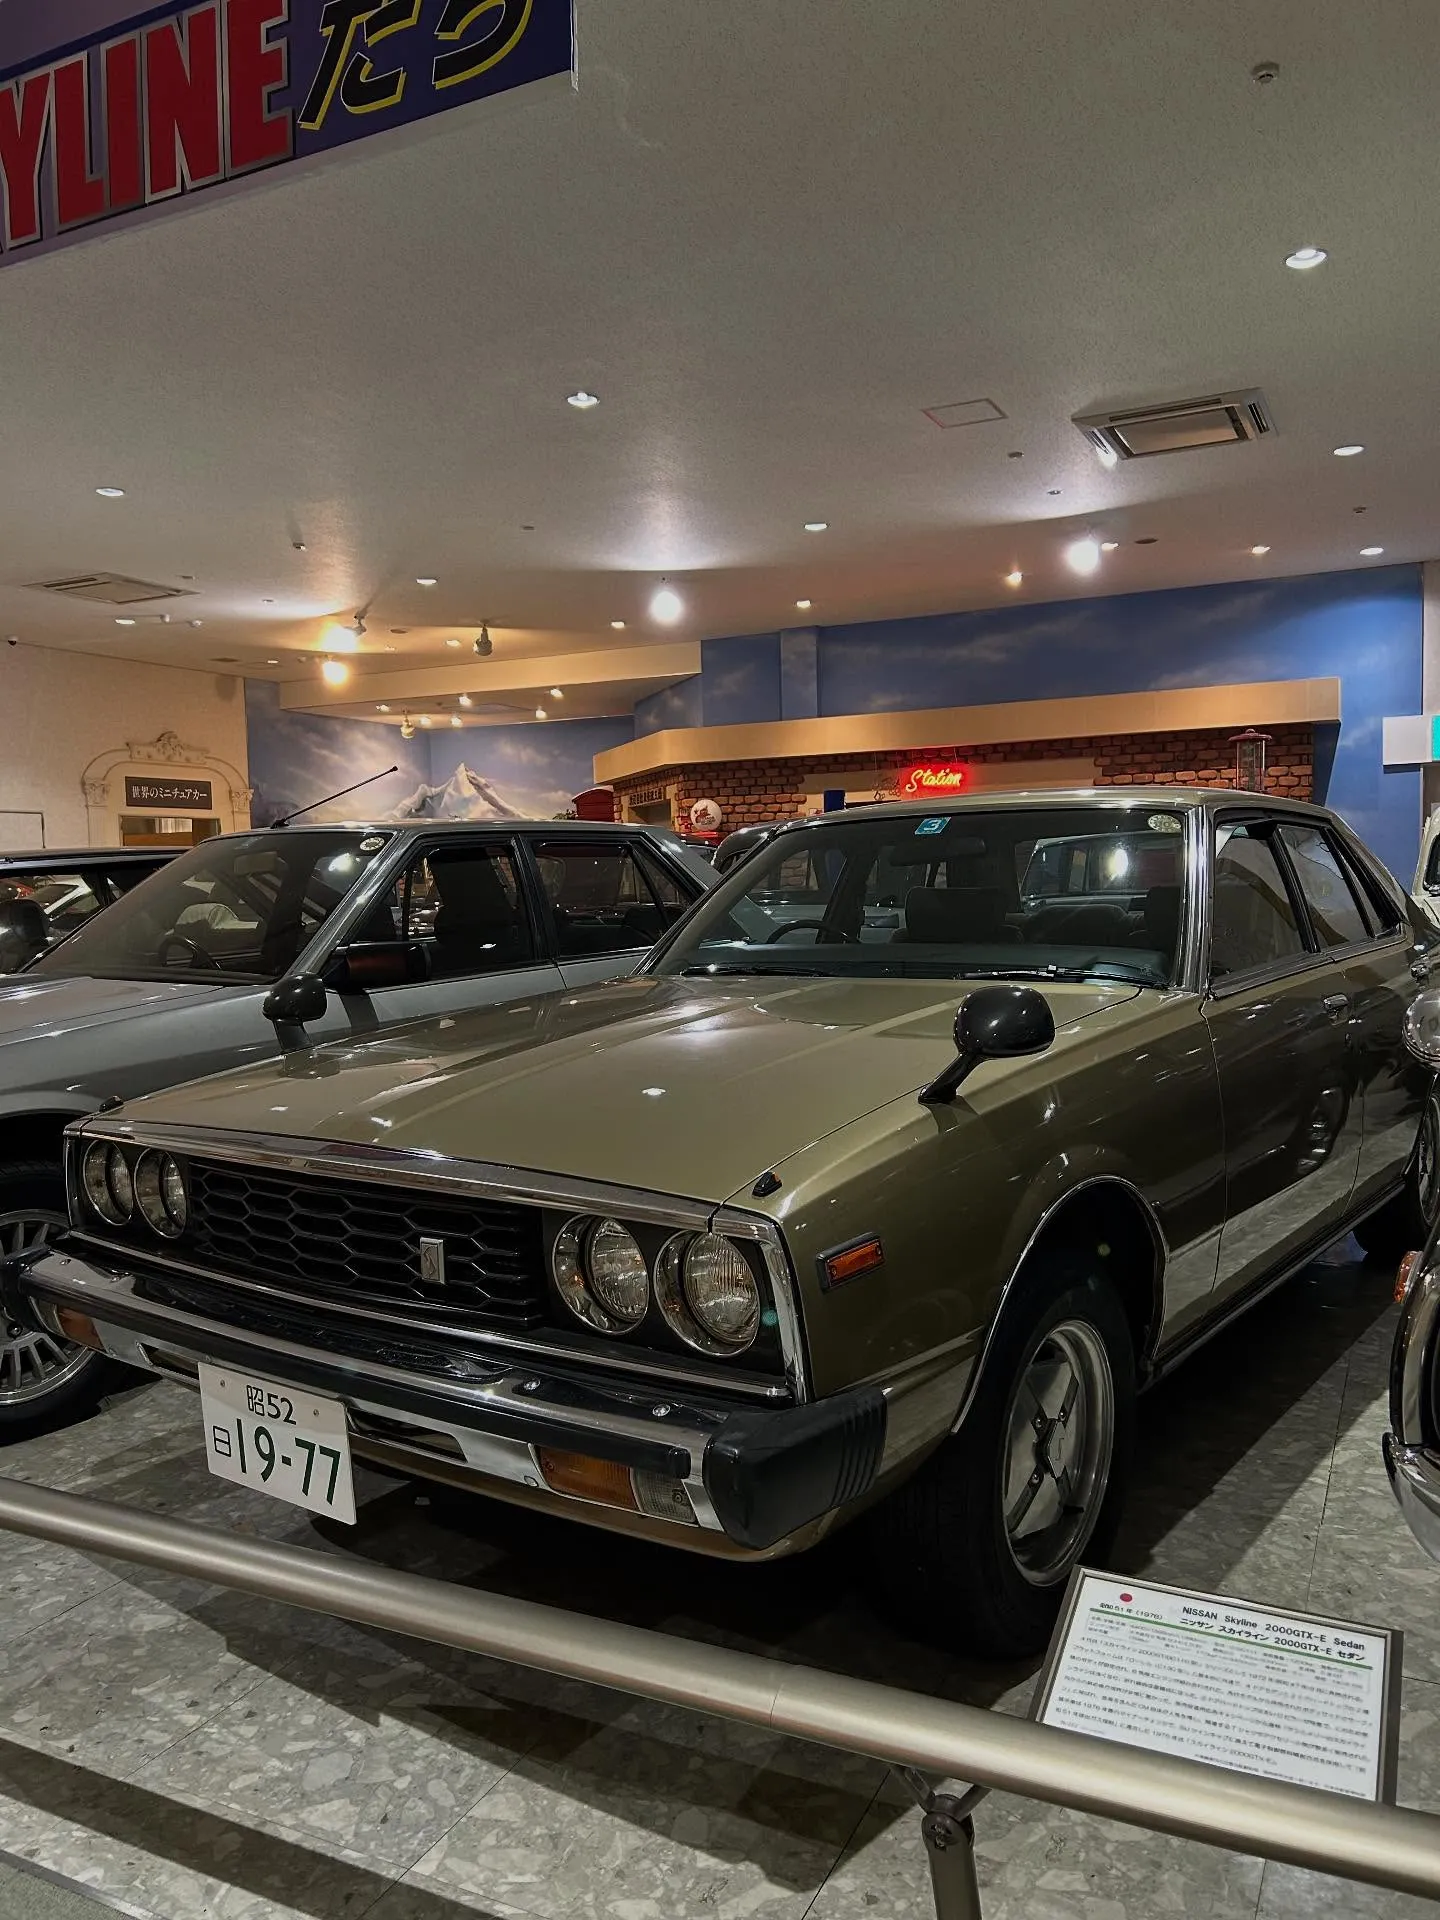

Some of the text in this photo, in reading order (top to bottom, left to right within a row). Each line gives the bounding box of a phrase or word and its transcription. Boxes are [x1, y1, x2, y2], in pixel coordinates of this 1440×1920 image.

[131, 785, 208, 801] 世界のミニチュアカー
[905, 768, 963, 793] Station
[923, 819, 942, 831] 3
[246, 1384, 297, 1426] 昭52
[236, 1418, 342, 1506] 19-77
[1180, 1618, 1214, 1629] ニッサン
[1218, 1625, 1270, 1641] スカイライン
[1274, 1637, 1332, 1656] 2000GTX-E
[1337, 1650, 1365, 1661] セダン
[1182, 1606, 1365, 1651] NISSAN Skyline 2000GTX-E Sedan
